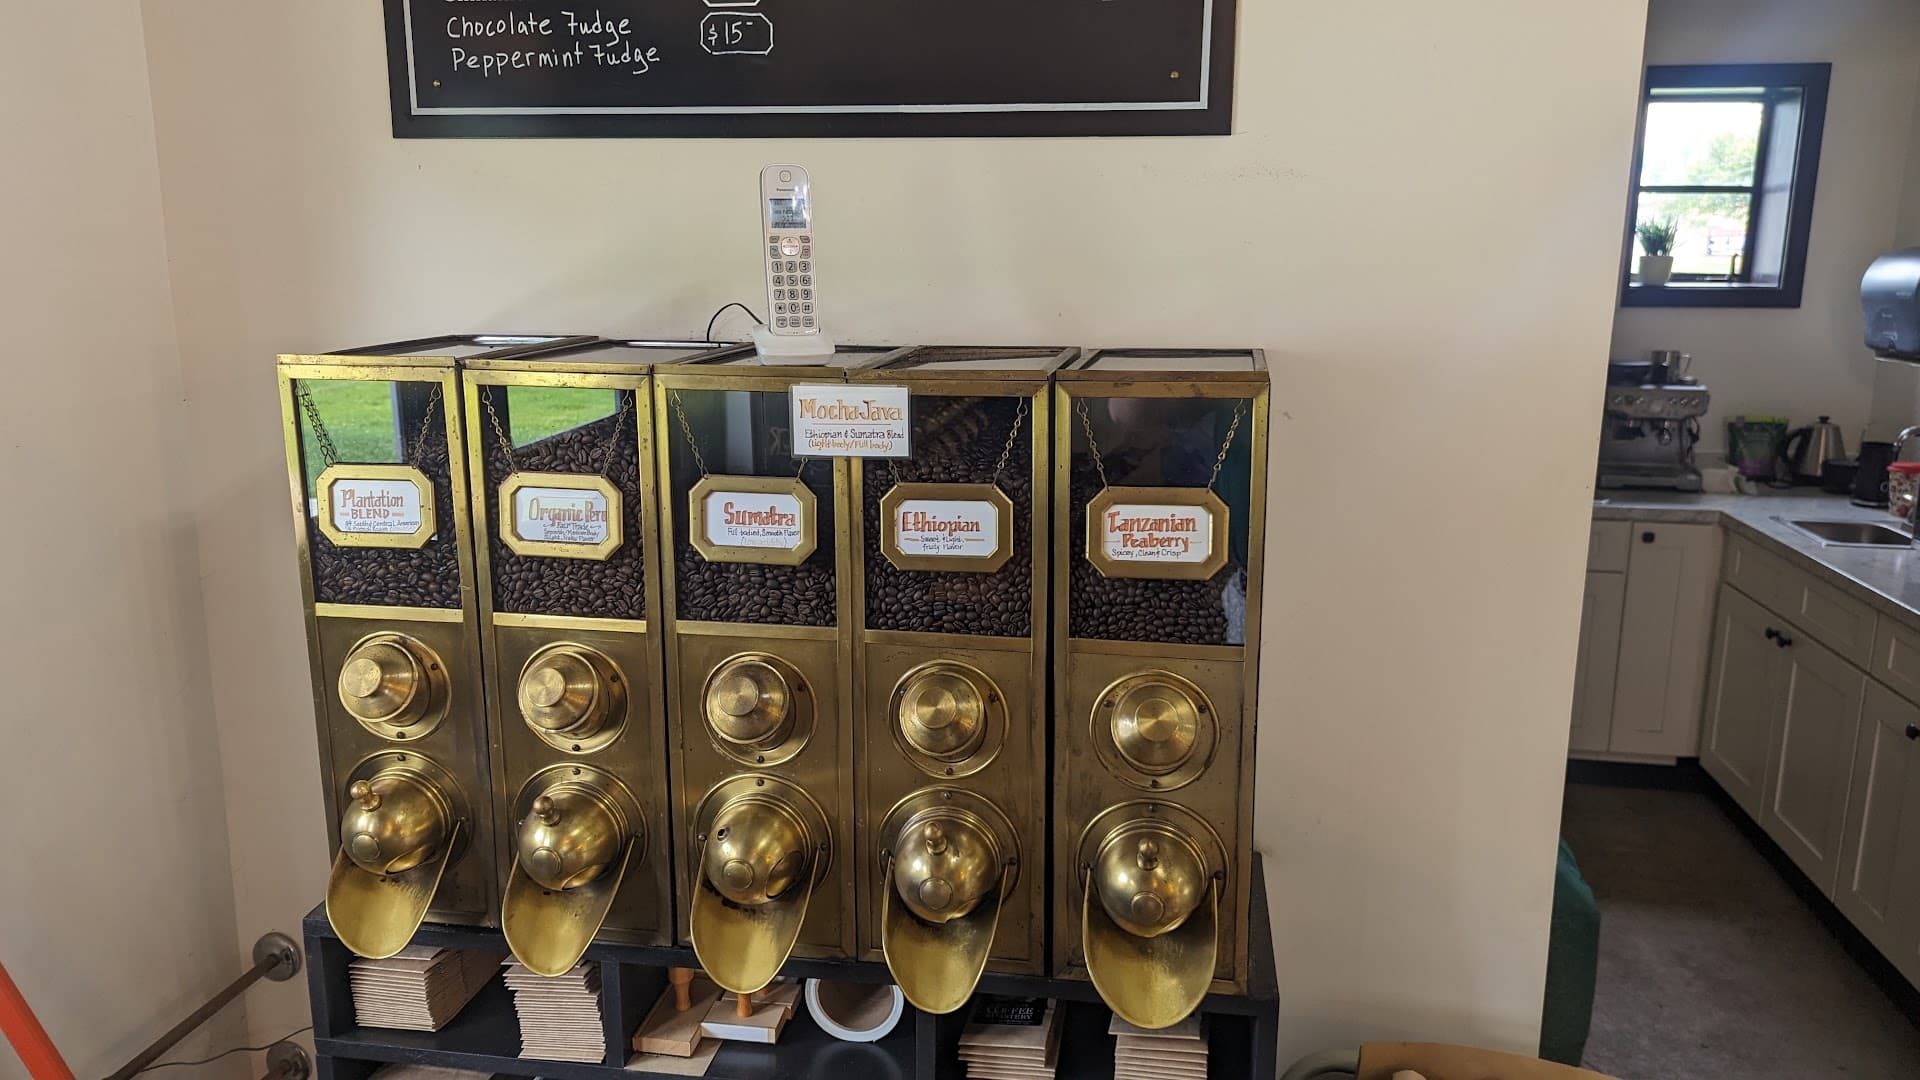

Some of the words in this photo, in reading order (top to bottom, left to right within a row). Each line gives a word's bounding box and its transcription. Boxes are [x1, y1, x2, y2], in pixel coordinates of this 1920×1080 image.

[446, 11, 553, 39] Chocolate
[561, 10, 632, 47] Fudge
[451, 42, 584, 77] Peppermint
[589, 42, 661, 75] Fudge
[805, 428, 842, 440] Ethiopian
[850, 428, 885, 439] Sumatra
[340, 489, 404, 508] Plantation
[351, 509, 390, 520] BLEND
[528, 498, 584, 527] Organic
[724, 501, 796, 526] Sumatra
[902, 511, 981, 536] Ethiopian
[1107, 511, 1198, 533] Tanzanian
[1122, 533, 1189, 552] Peaberry
[1161, 548, 1181, 559] Crisp
